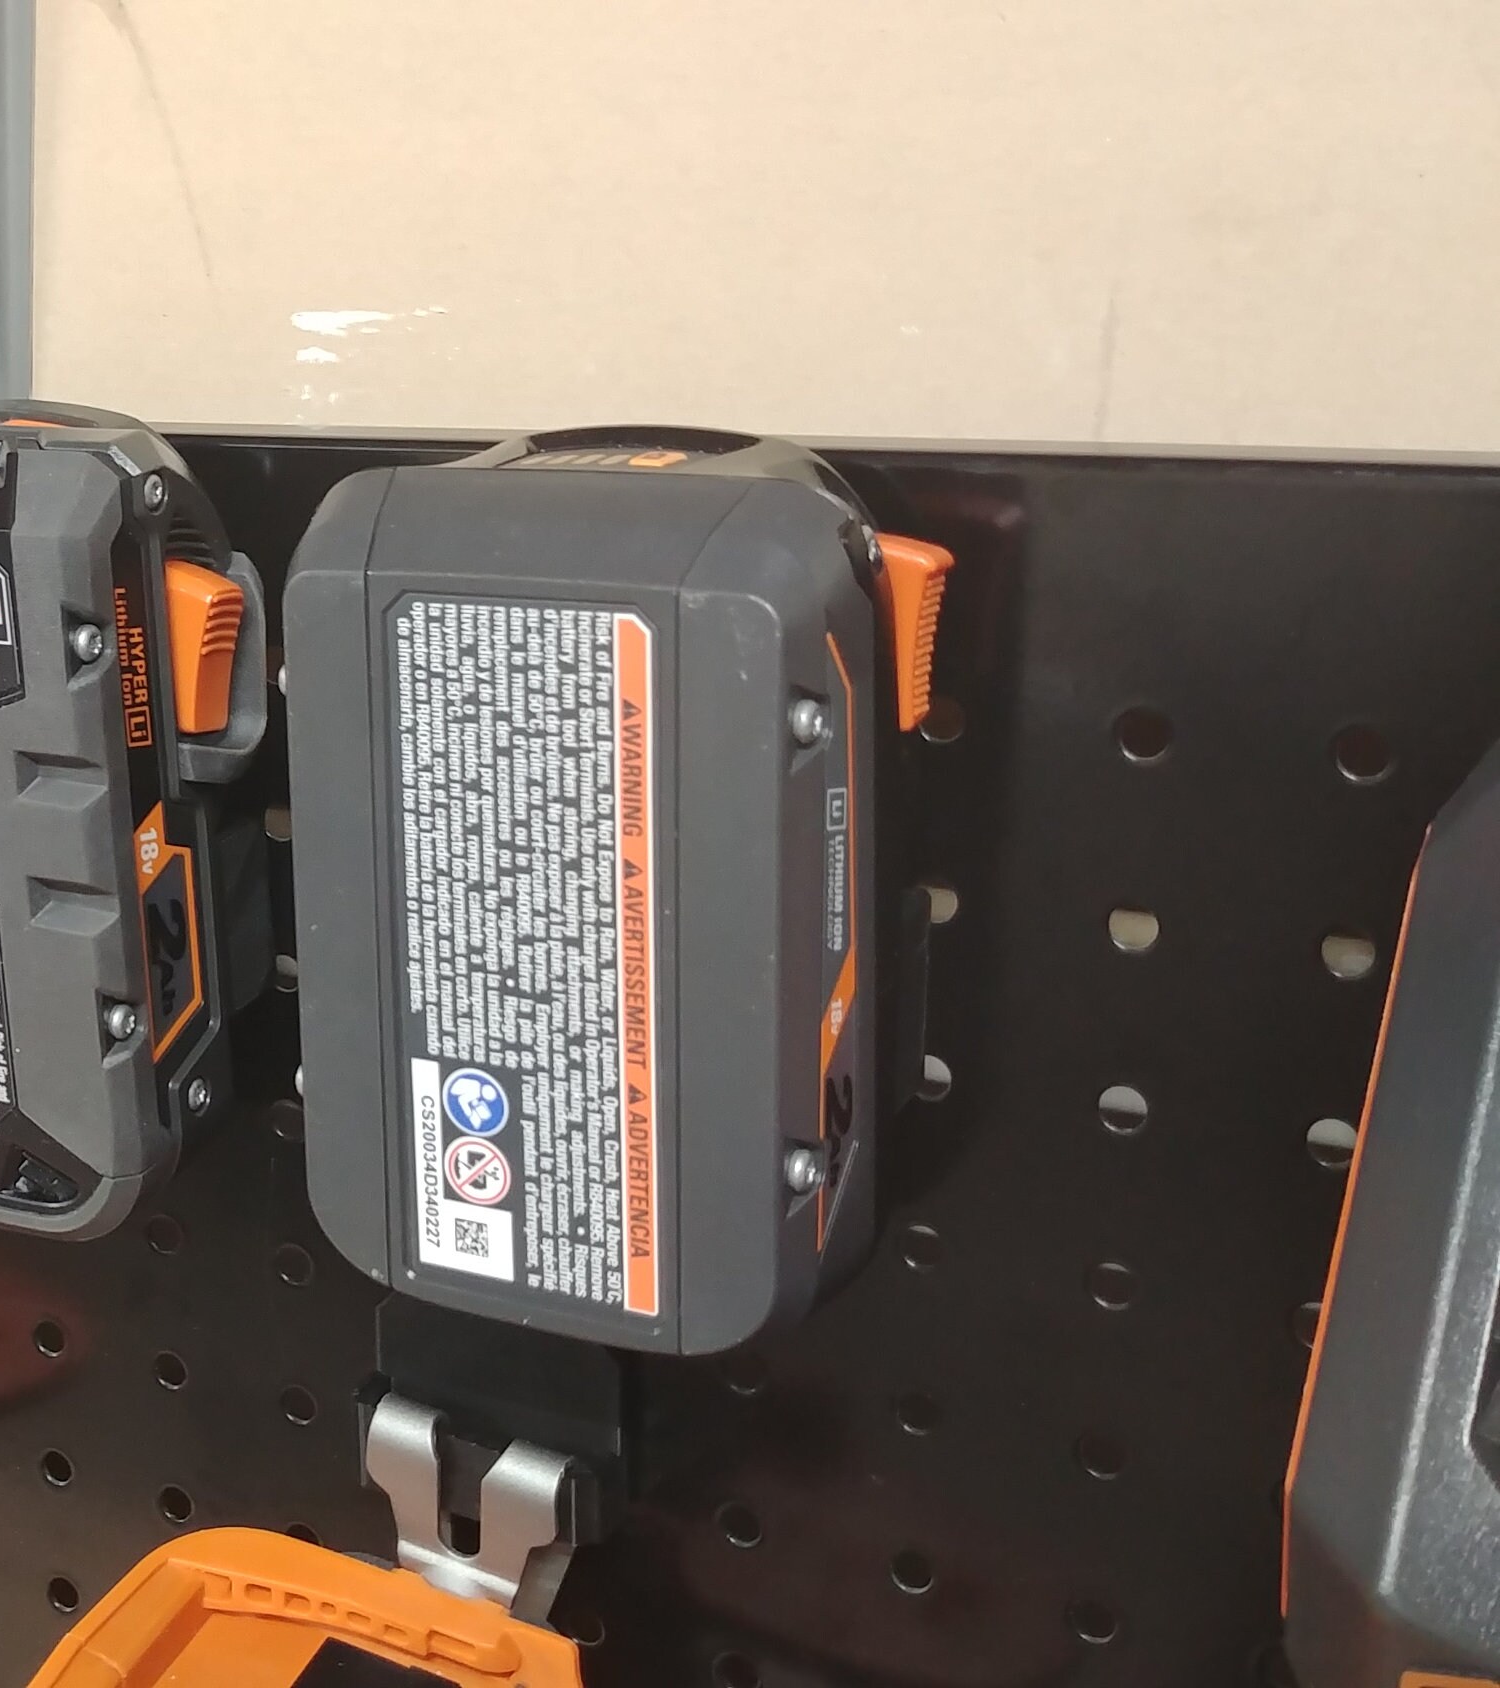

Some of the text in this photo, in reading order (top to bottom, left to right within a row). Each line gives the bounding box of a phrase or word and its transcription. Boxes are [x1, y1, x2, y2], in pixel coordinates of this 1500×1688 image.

[114, 587, 130, 666] Lithium
[558, 608, 575, 664] battery
[595, 611, 610, 646] Risk
[128, 627, 148, 702] HYPER
[596, 650, 610, 667] of
[562, 672, 576, 710] from
[579, 687, 590, 705] or
[596, 671, 610, 702] Fire
[563, 718, 576, 748] tool
[579, 706, 594, 748] Short
[597, 706, 611, 736] and
[564, 756, 577, 798] when
[597, 739, 612, 789] Burns.
[598, 792, 612, 815] Do
[562, 806, 578, 863] storing,
[582, 826, 596, 855] Use
[598, 818, 612, 846] Not
[579, 855, 596, 889] only
[596, 848, 613, 903] Expose
[833, 835, 845, 912] LITHIUM
[563, 869, 580, 938] changing
[583, 889, 597, 923] with
[600, 906, 614, 923] to
[581, 923, 598, 981] charger
[599, 925, 614, 965] Rain,
[585, 981, 599, 1022] listed
[600, 966, 615, 1014] Water,
[622, 723, 650, 1258] WARNING AVERTISSEMENT ADVERTENCIA
[586, 1022, 599, 1038] in
[602, 1015, 613, 1033] or
[570, 1044, 580, 1062] or
[599, 1035, 616, 1093] Liquids,
[567, 1068, 583, 1123] making
[600, 1094, 617, 1137] Open,
[588, 1111, 601, 1165] Manual
[419, 1094, 441, 1247] CS20034D340227
[589, 1164, 599, 1181] or
[603, 1138, 617, 1185] Crush,
[589, 1181, 603, 1246] R840095.
[605, 1186, 618, 1222] Heat
[606, 1223, 619, 1268] Above
[590, 1245, 604, 1302] Remove
